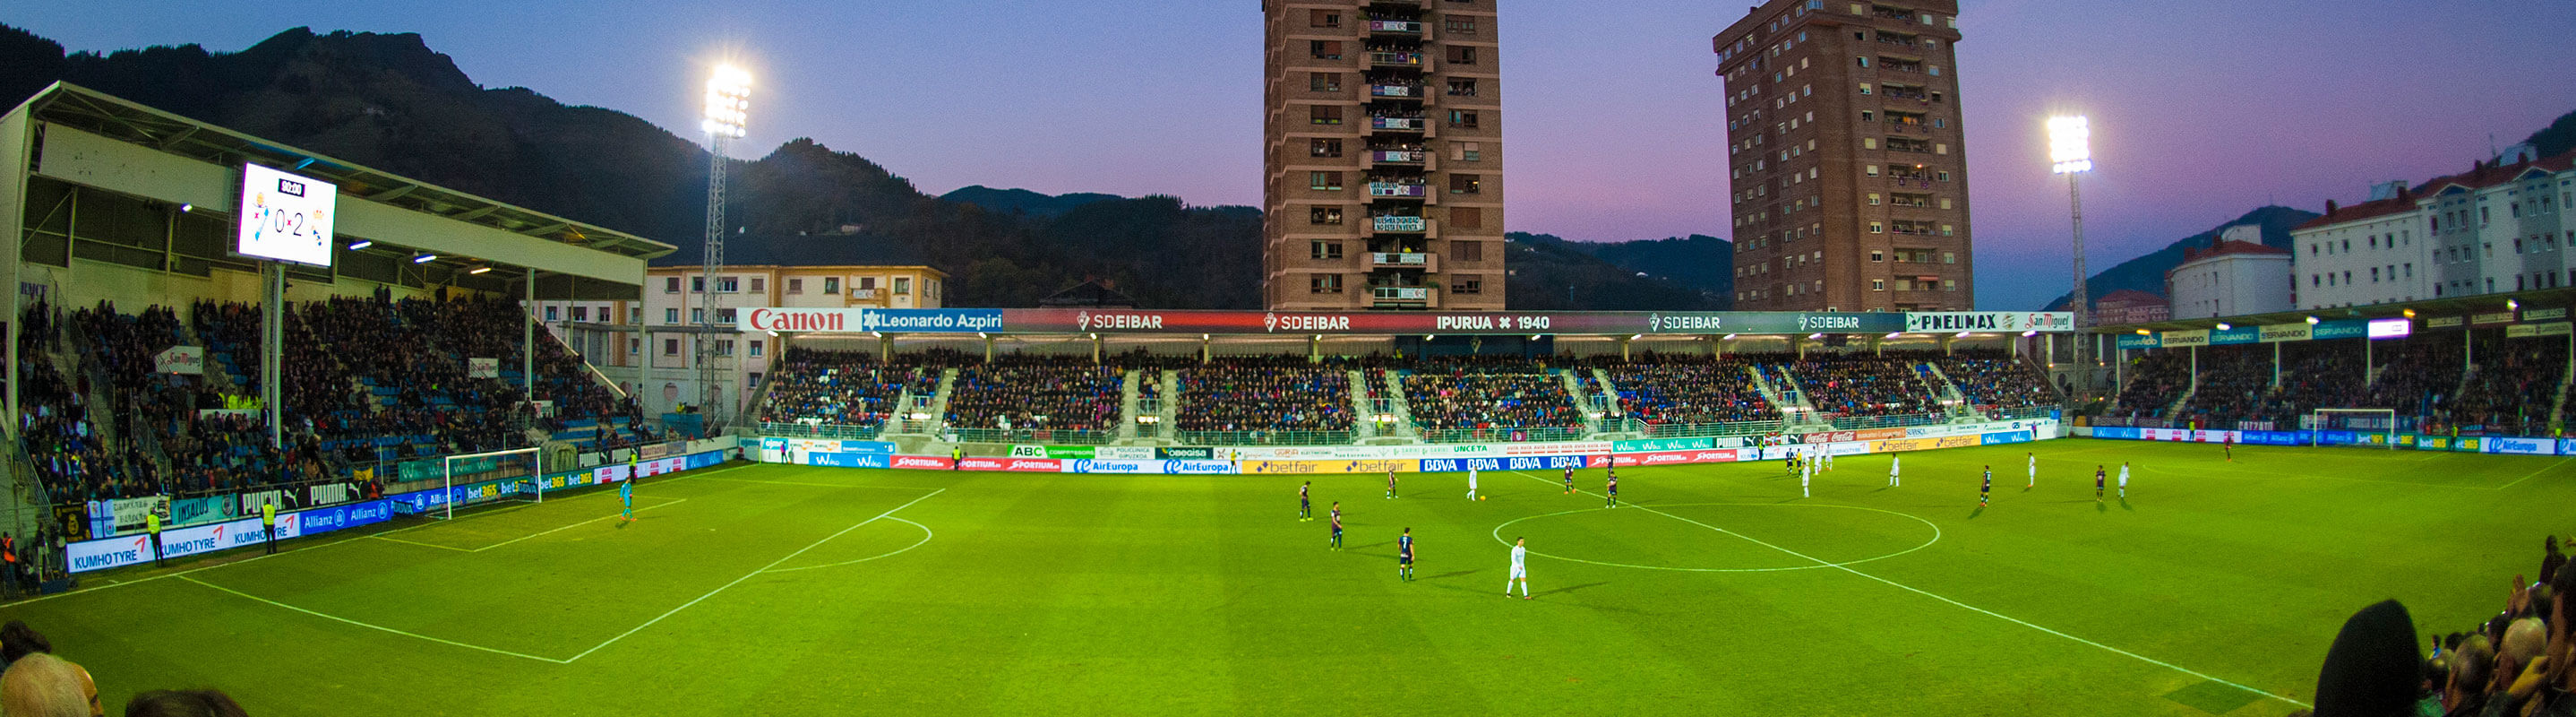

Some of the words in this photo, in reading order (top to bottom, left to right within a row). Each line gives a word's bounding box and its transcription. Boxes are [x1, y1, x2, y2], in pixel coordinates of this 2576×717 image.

[275, 209, 285, 232] 0
[293, 212, 304, 236] 2
[751, 308, 844, 330] Canon
[881, 314, 953, 327] Leonardo
[957, 314, 1001, 330] Azpiri
[1437, 316, 1493, 330] IPURUA
[1517, 316, 1550, 329] 1940
[1921, 314, 1996, 329] PNEUMAX
[2211, 333, 2254, 341] SERVANDO
[2314, 327, 2363, 336] SERVANDO
[2164, 336, 2204, 344] SERVANDO
[1887, 439, 1919, 451] betfair
[1944, 436, 1973, 447] betfair
[1015, 447, 1043, 456] ABC
[1454, 445, 1488, 453] UNCETA
[1270, 461, 1318, 472] betfair
[1359, 460, 1406, 472] betfair
[1424, 459, 1457, 471] BBVA
[1467, 458, 1499, 471] BBVA
[1509, 457, 1541, 469] BBVA
[1550, 456, 1582, 468] BBVA
[568, 472, 592, 485] bet365
[311, 482, 348, 505] PUMA
[468, 484, 497, 498] bet365
[243, 490, 282, 514] PUMA
[178, 498, 209, 523] INSALUS
[351, 508, 376, 521] Allianz
[305, 515, 332, 529] Allianz
[235, 529, 265, 544] KUMHO
[193, 537, 215, 550] TYRE
[74, 553, 113, 569] KUMHO
[113, 549, 137, 564] TYRE
